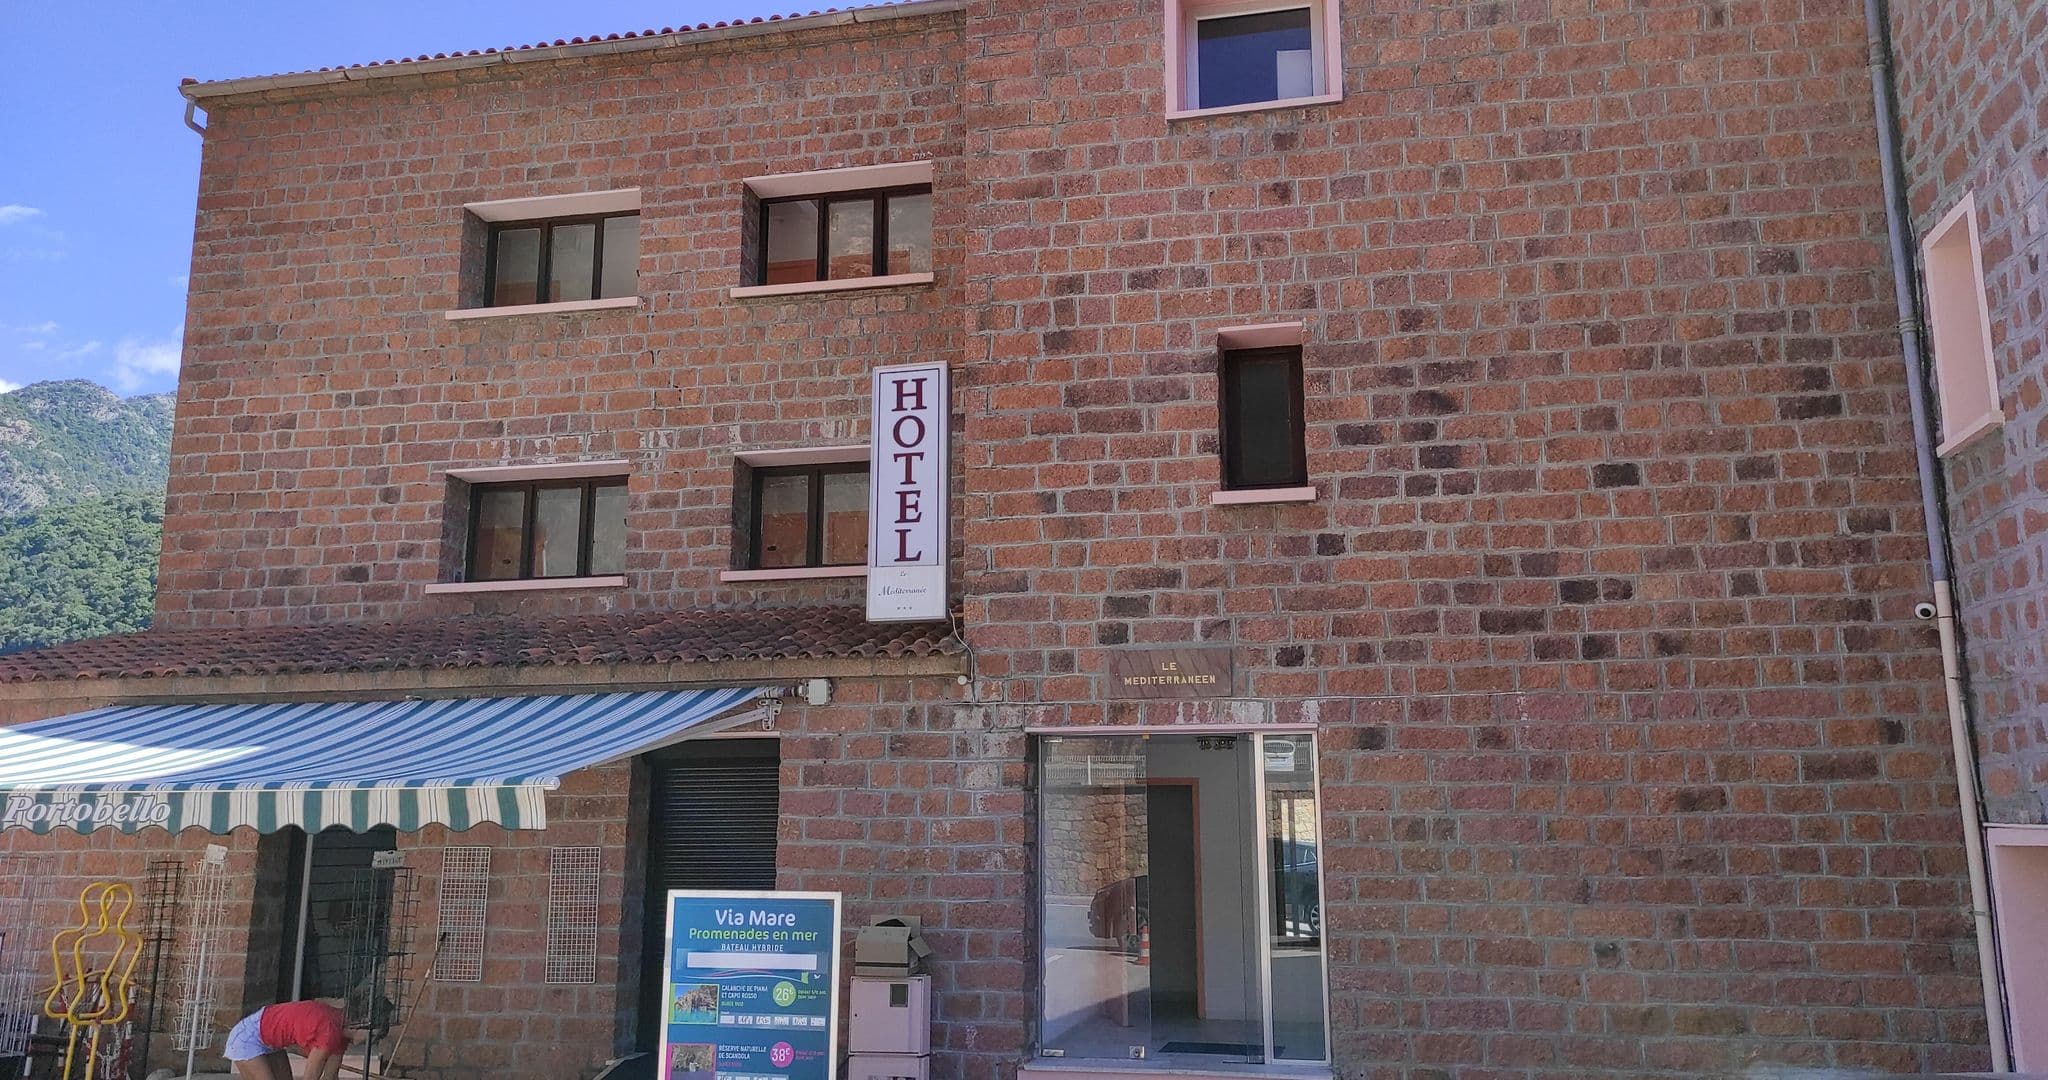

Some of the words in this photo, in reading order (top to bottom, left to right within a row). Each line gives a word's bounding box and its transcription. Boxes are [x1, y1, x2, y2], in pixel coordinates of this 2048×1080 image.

[891, 377, 928, 562] HOTEL
[1161, 662, 1177, 671] LE
[1123, 674, 1217, 686] MEDITERRANEEN
[1, 795, 172, 823] Portobello
[715, 908, 744, 926] Via
[749, 910, 796, 927] Mare
[689, 927, 769, 940] Promenades
[772, 930, 788, 941] en
[791, 931, 818, 942] mer
[721, 943, 749, 952] BATEAU
[751, 944, 784, 952] HYBRIDE
